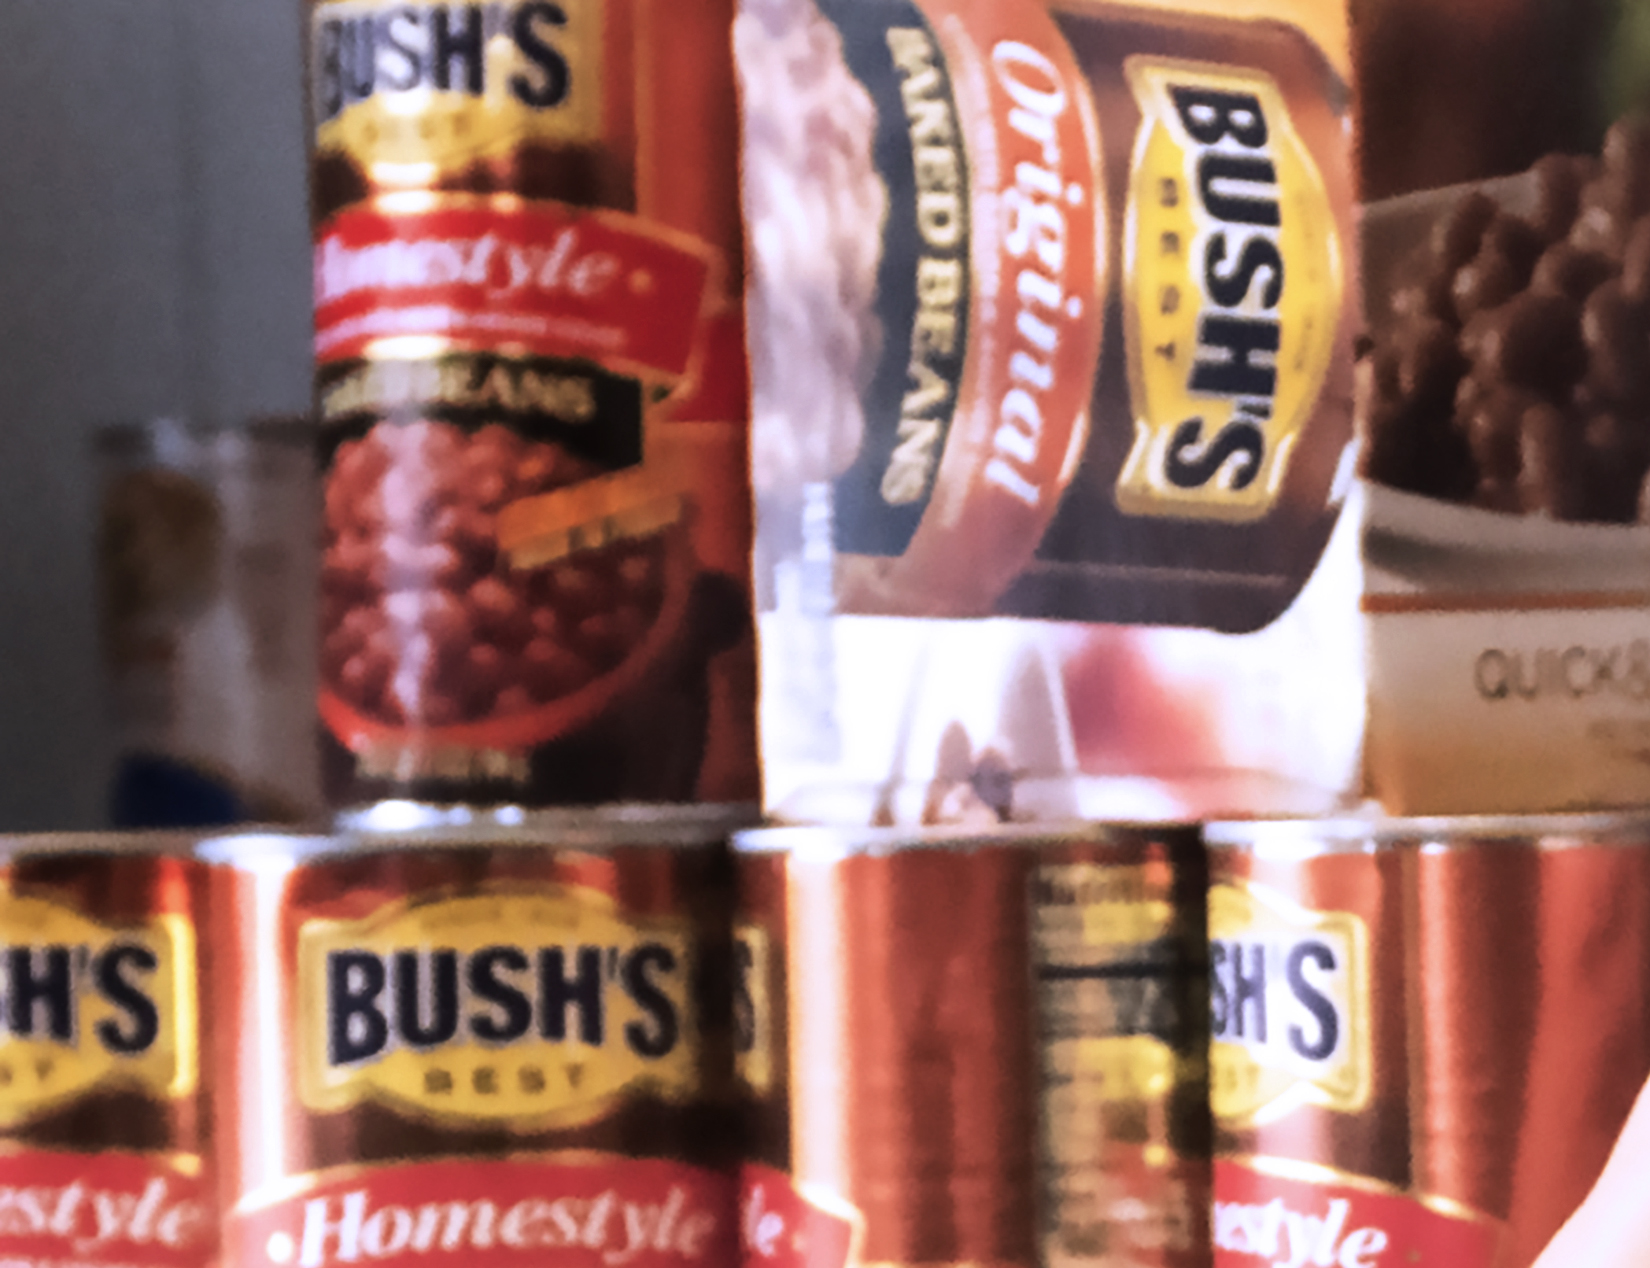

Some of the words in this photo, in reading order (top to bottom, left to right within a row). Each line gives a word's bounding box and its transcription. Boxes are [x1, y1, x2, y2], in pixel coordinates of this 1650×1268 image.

[888, 28, 957, 247] BAKED
[878, 257, 962, 504] BEANS
[992, 40, 1083, 505] Original
[1165, 82, 1284, 491] BUSH'S
[328, 943, 679, 1066] BUSH'S
